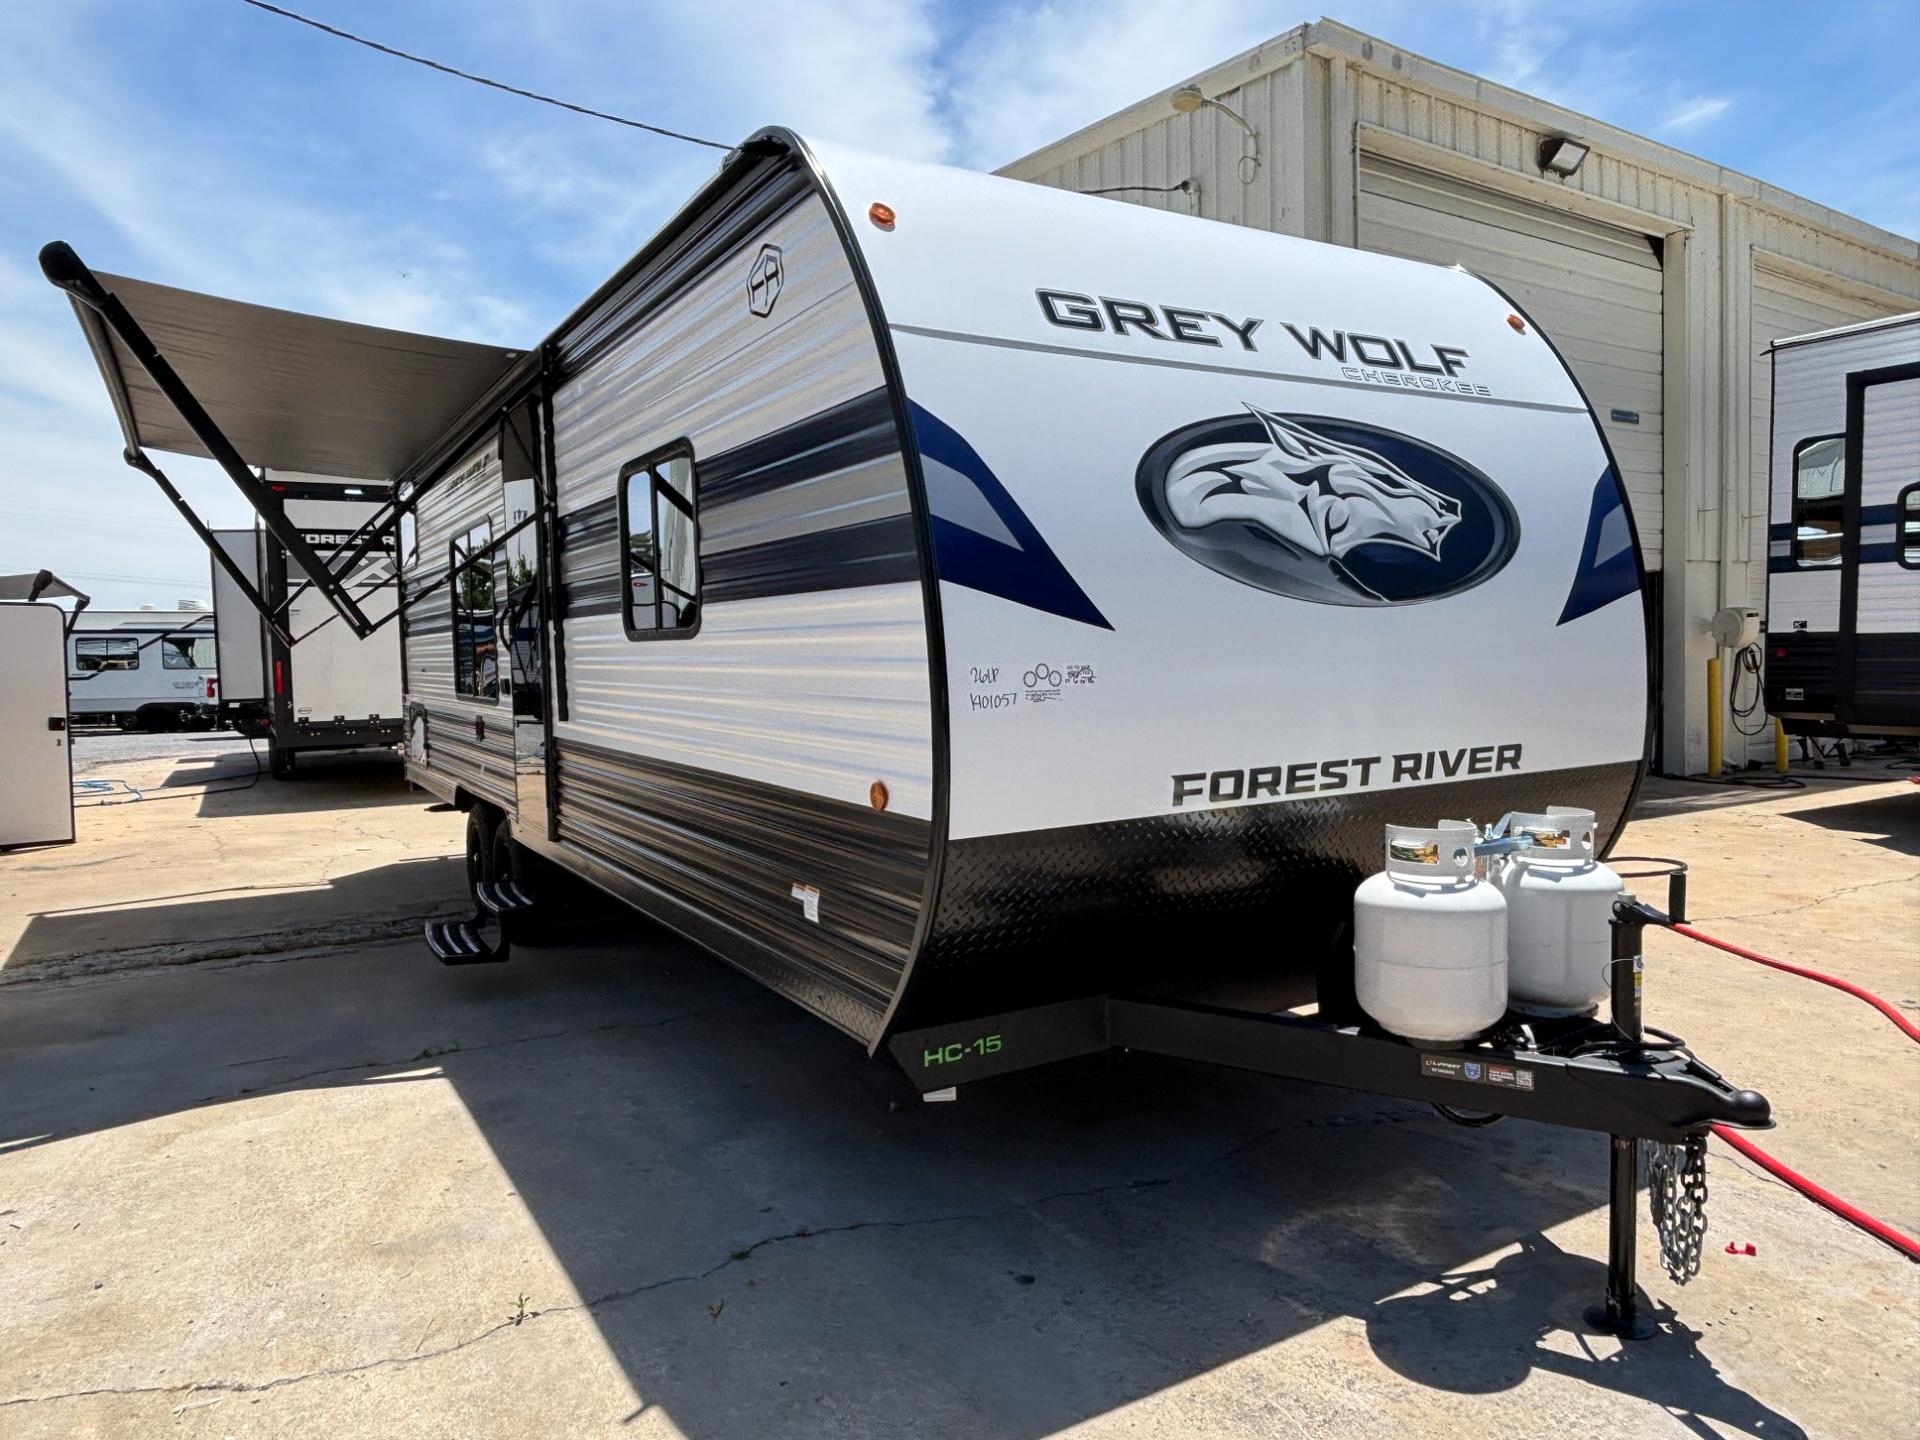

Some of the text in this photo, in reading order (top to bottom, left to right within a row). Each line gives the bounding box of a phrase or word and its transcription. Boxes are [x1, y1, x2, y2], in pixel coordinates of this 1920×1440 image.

[1034, 287, 1471, 377] GREY WOLF
[1340, 367, 1493, 397] CHEROKEE
[1170, 743, 1523, 807] FOREST RIVER
[923, 1034, 1002, 1068] HC-15
